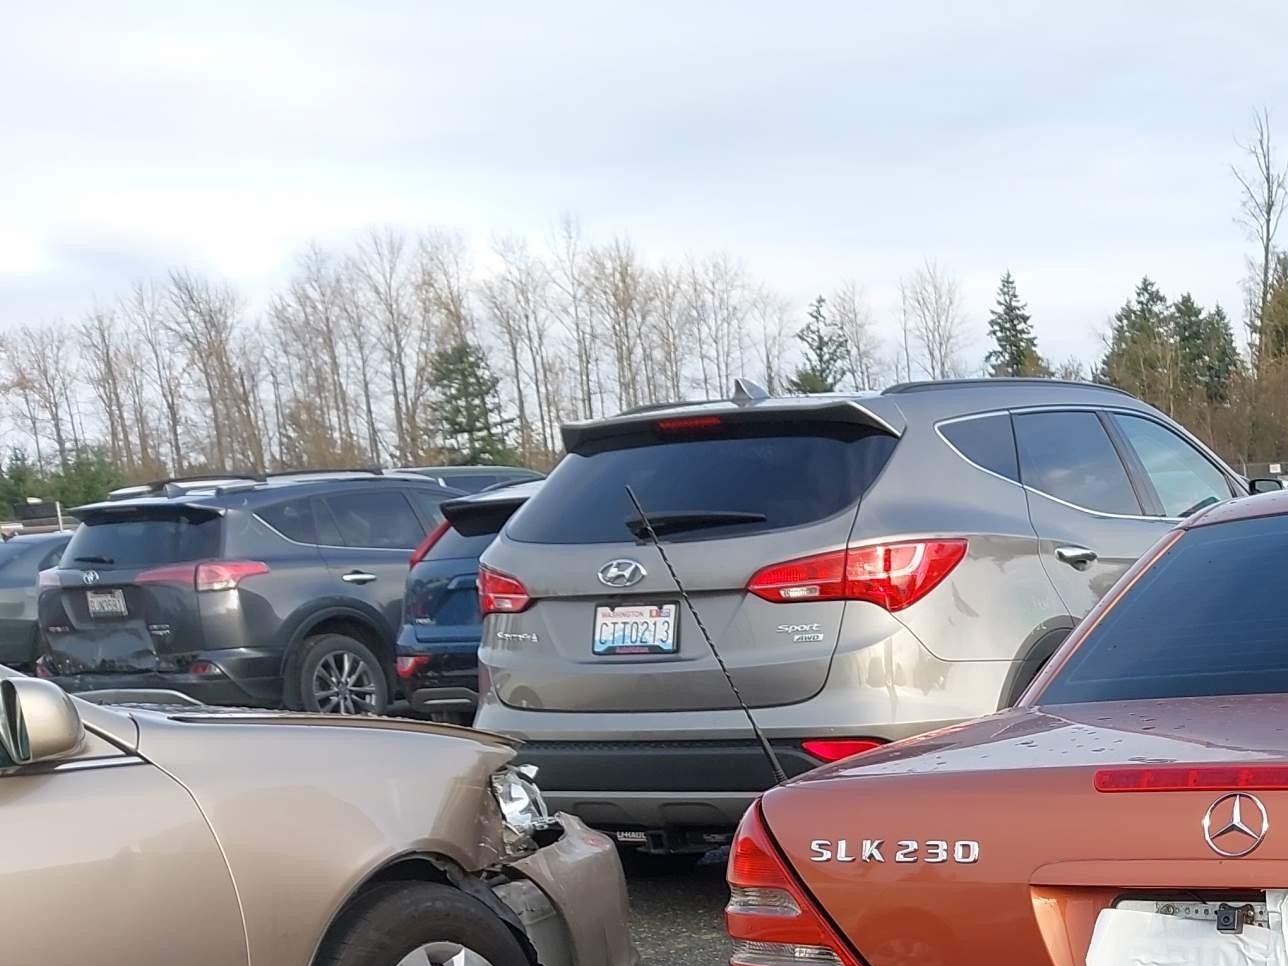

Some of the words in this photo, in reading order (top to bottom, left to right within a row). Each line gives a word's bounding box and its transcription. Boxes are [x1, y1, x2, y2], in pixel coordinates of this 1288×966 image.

[599, 620, 670, 645] CTT0213
[776, 623, 822, 633] Sport
[809, 839, 885, 863] SLK
[895, 840, 980, 864] 230
